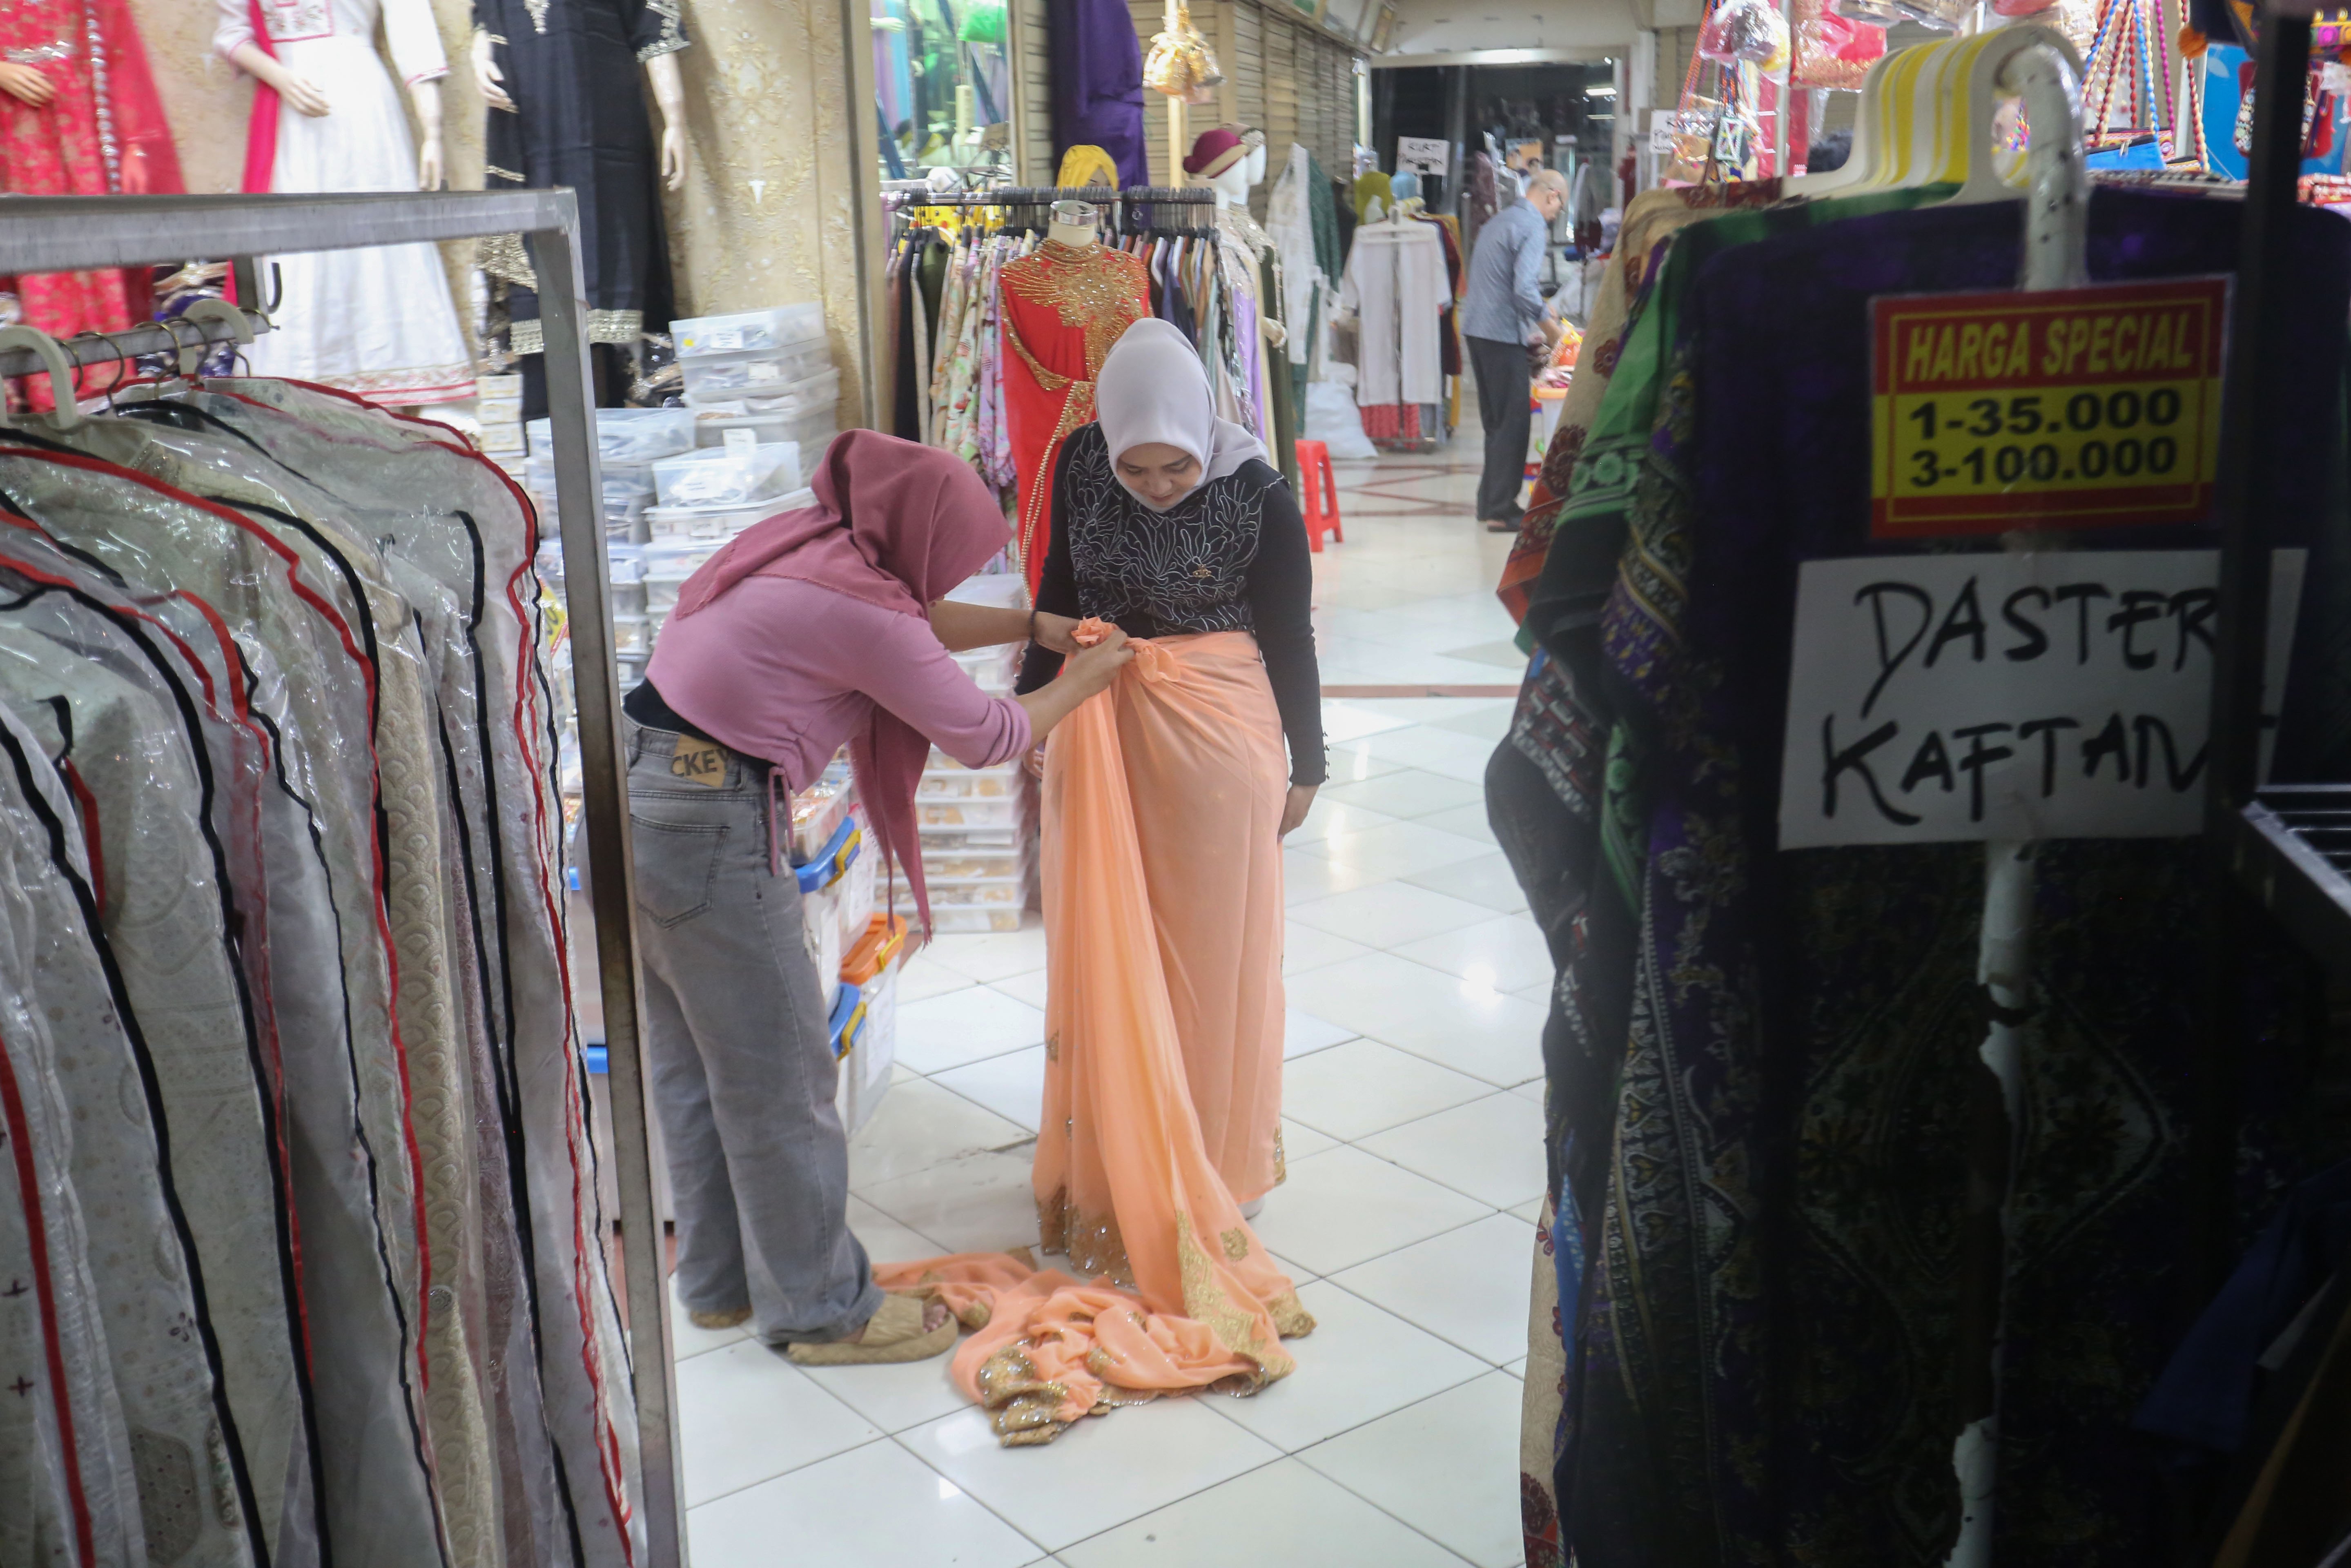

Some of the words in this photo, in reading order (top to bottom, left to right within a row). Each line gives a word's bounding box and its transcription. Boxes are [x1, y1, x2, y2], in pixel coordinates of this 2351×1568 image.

[1905, 321, 2030, 383] HARGA
[2042, 312, 2193, 376] SPECIAL
[1910, 388, 2180, 440] 1-35.000
[1910, 436, 2177, 488] 3-100.000
[1853, 576, 2217, 720] DASTER
